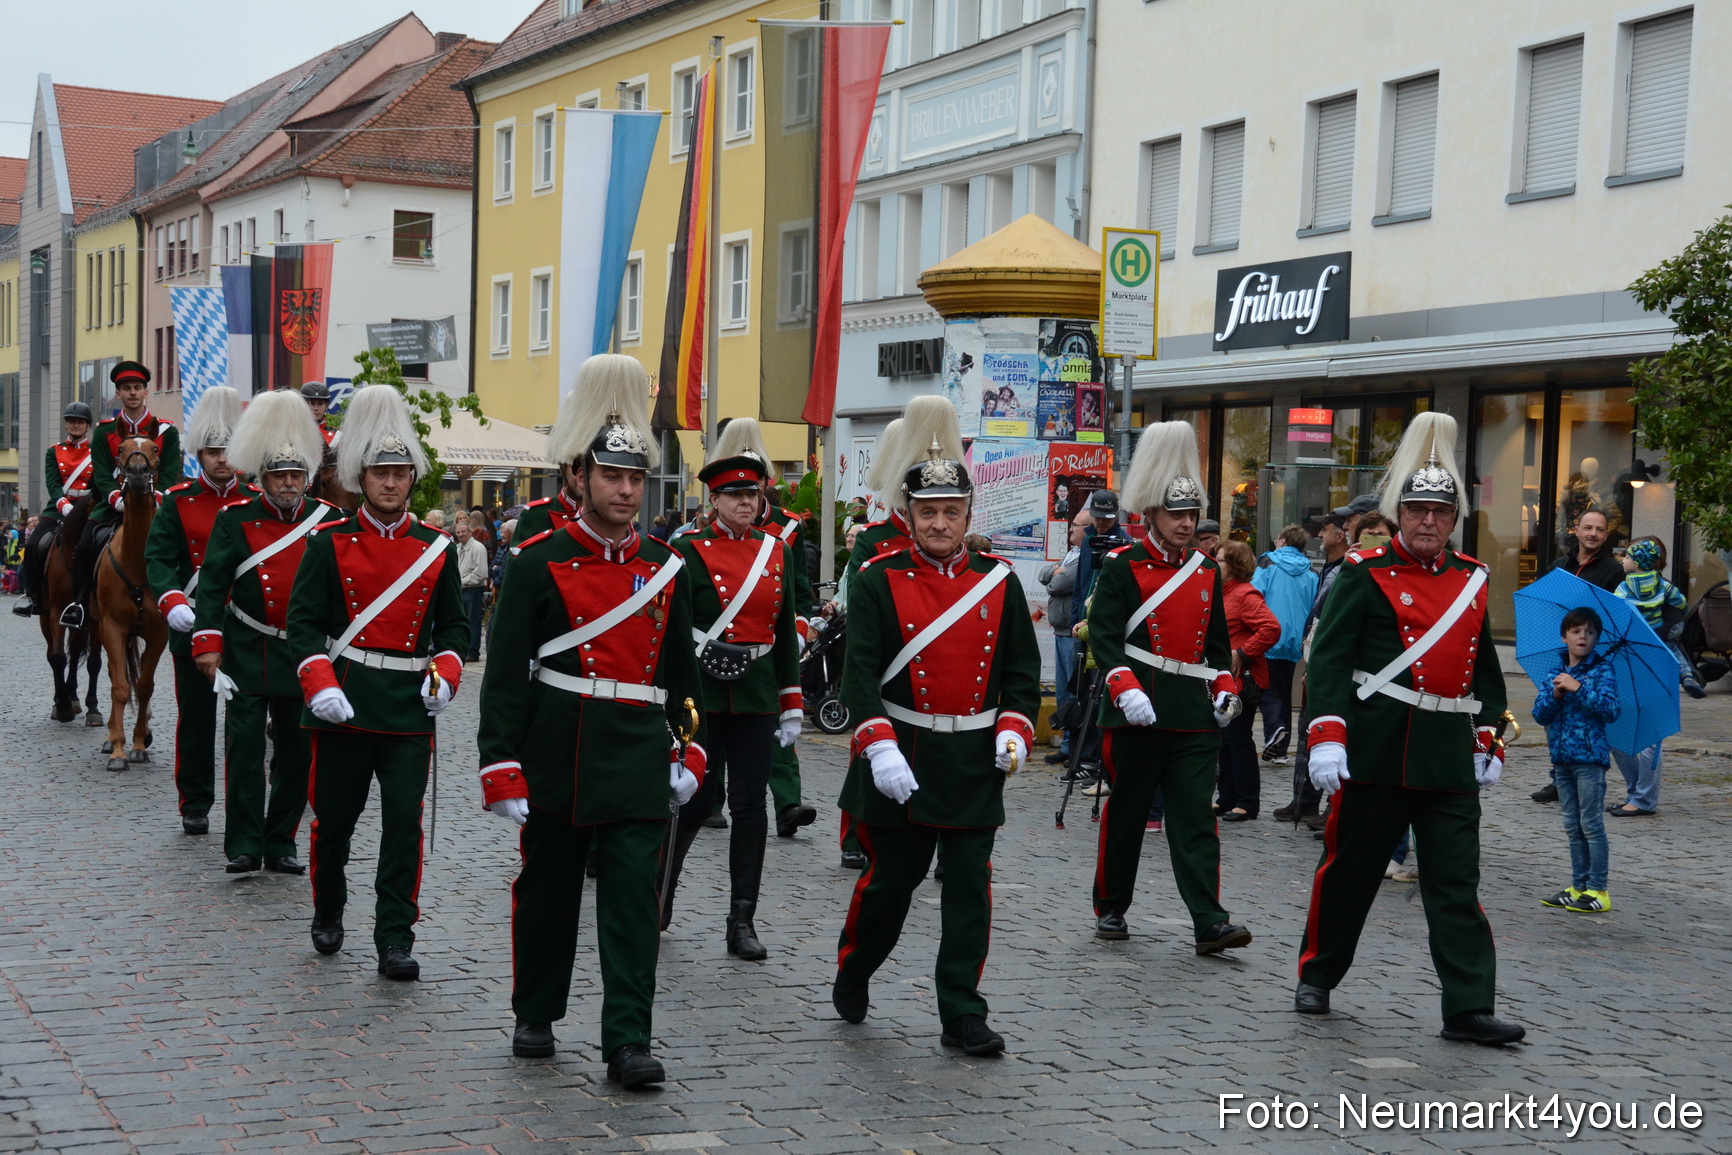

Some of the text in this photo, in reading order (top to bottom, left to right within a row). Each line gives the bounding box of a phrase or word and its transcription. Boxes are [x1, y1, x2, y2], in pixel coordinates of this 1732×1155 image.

[910, 84, 1015, 143] BRILLEN WEBER
[1121, 249, 1140, 277] H
[1111, 291, 1148, 302] Marktplatz
[1215, 264, 1341, 343] frühauf
[878, 338, 934, 378] BRILLEN
[1305, 432, 1325, 440] HotSpot
[446, 446, 531, 457] Neumarkter
[984, 450, 1003, 465] Open
[973, 451, 1050, 487] Kinosommer
[1004, 473, 1035, 487] August
